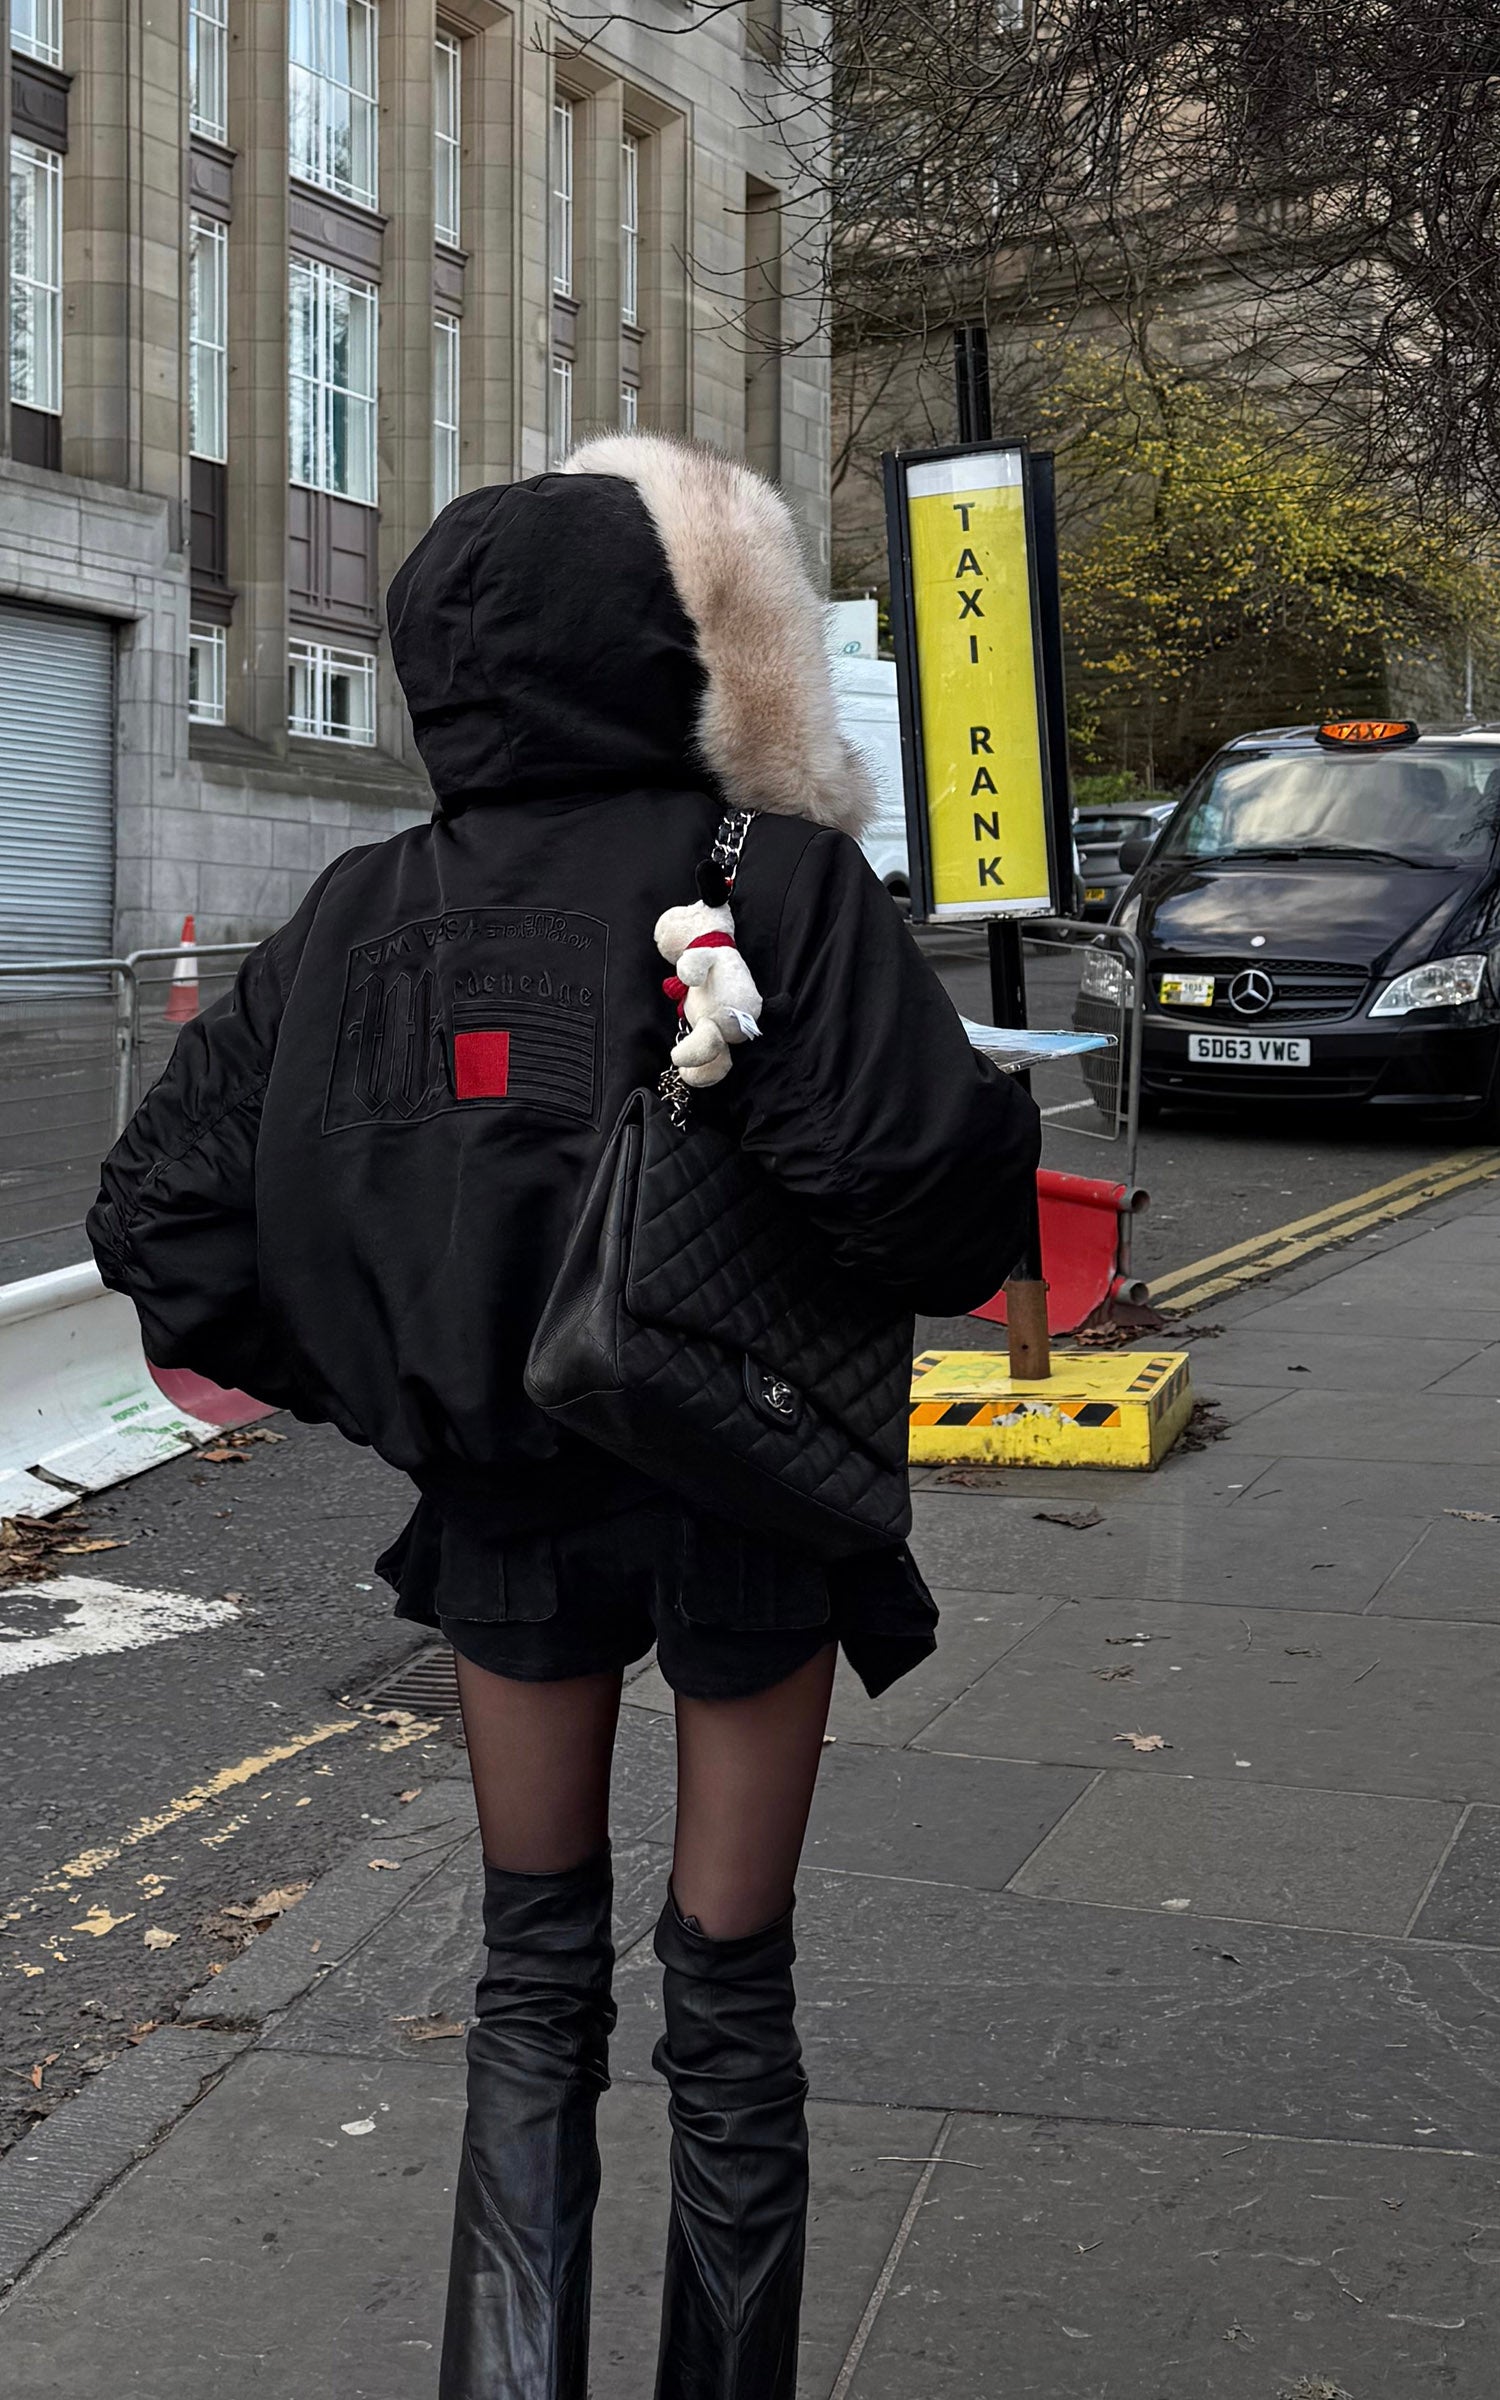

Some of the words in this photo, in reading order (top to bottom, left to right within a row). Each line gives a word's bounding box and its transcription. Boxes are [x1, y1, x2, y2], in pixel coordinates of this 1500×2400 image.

[953, 502, 985, 664] TAXI
[970, 726, 1005, 886] RANK
[1337, 723, 1388, 740] TAXI
[1258, 1040, 1300, 1062] VWE
